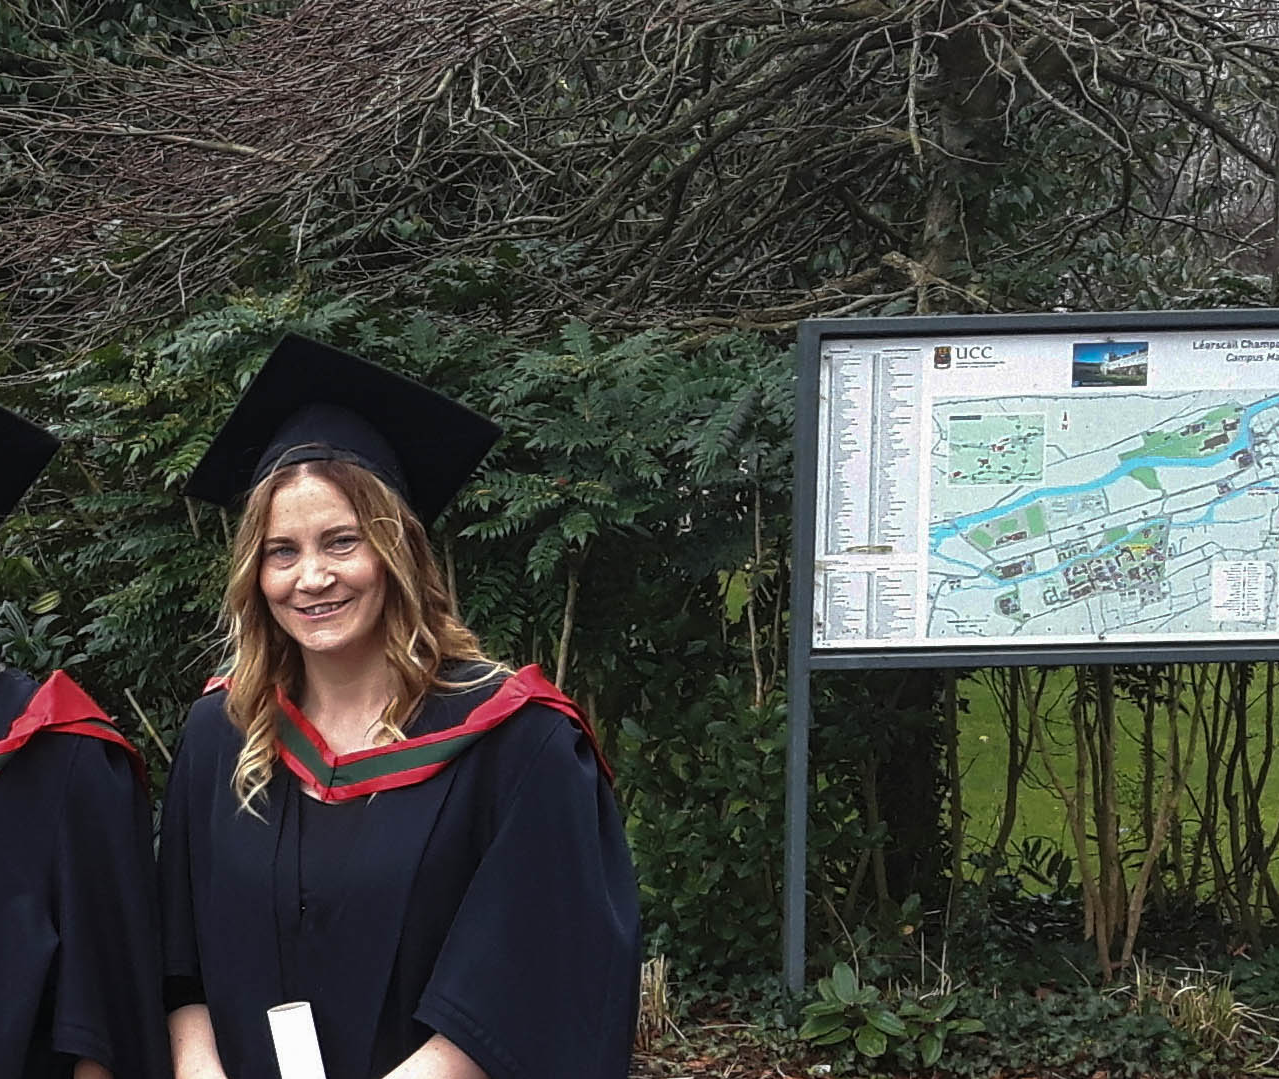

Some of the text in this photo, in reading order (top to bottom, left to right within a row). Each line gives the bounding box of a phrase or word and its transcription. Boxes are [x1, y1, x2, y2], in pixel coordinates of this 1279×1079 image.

[955, 346, 993, 360] UCC
[1226, 353, 1279, 363] Campus Ma
